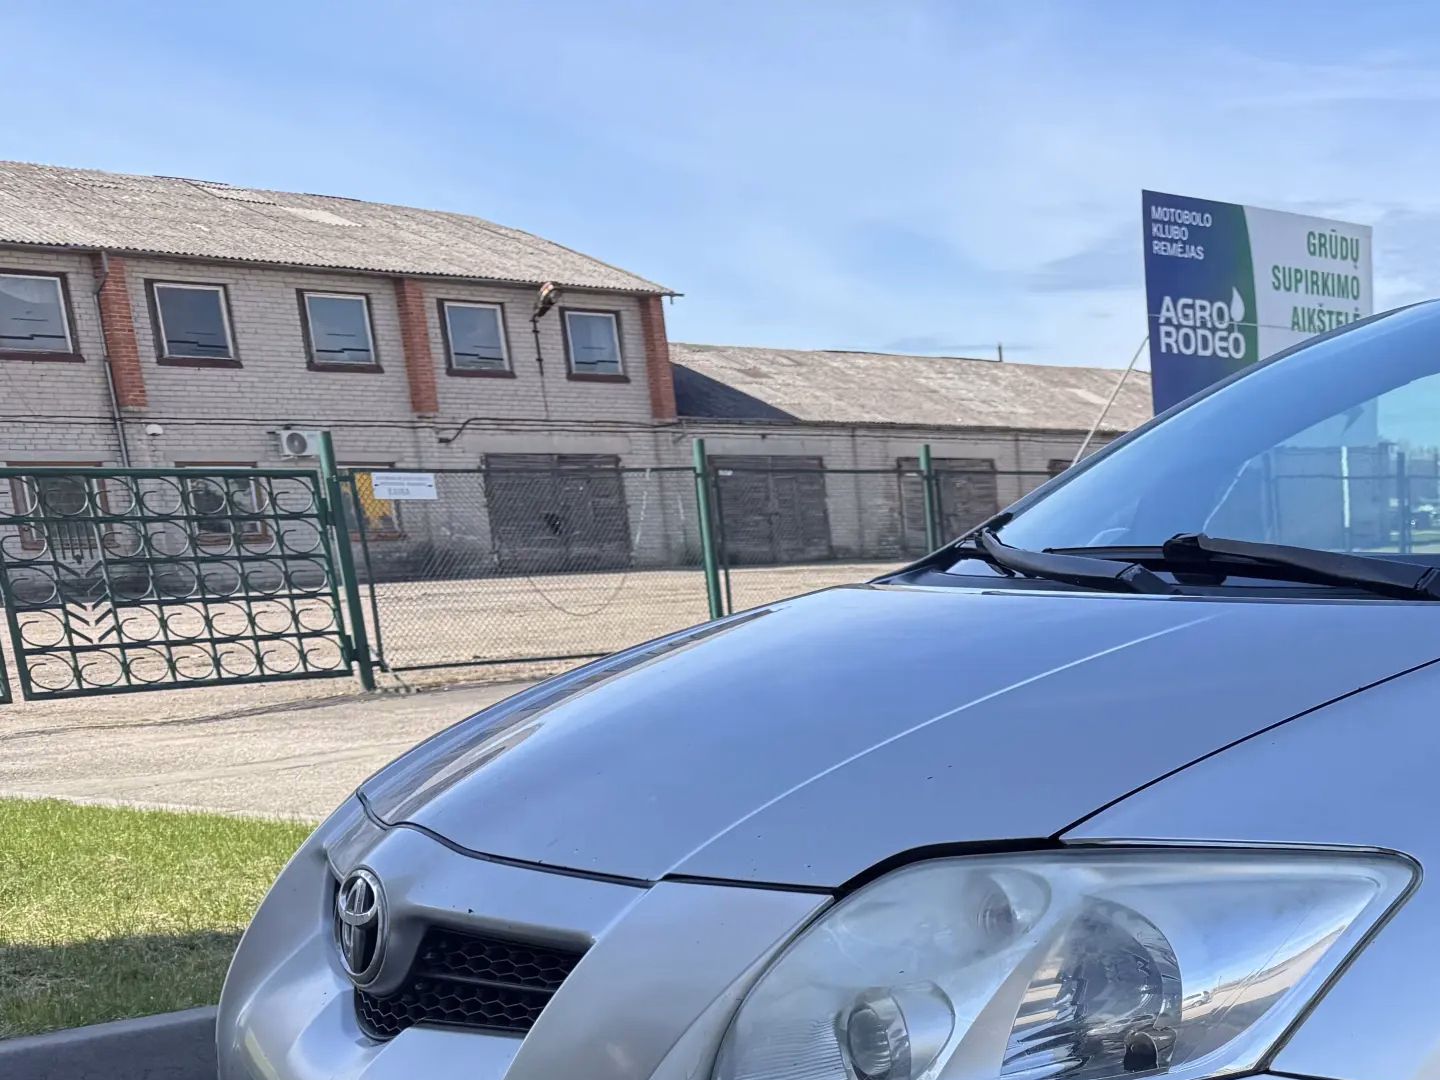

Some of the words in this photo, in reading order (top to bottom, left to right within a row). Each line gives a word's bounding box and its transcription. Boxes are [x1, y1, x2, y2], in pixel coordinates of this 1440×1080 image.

[1151, 205, 1212, 228] MOTOBOLO
[1151, 222, 1189, 241] KLUBO
[1152, 240, 1205, 260] REMĖJAS
[1307, 229, 1360, 270] GRŪDŲ
[1271, 264, 1360, 301] SUPIRKIMO
[1159, 295, 1230, 329] AGRO
[1159, 329, 1246, 359] RODEO
